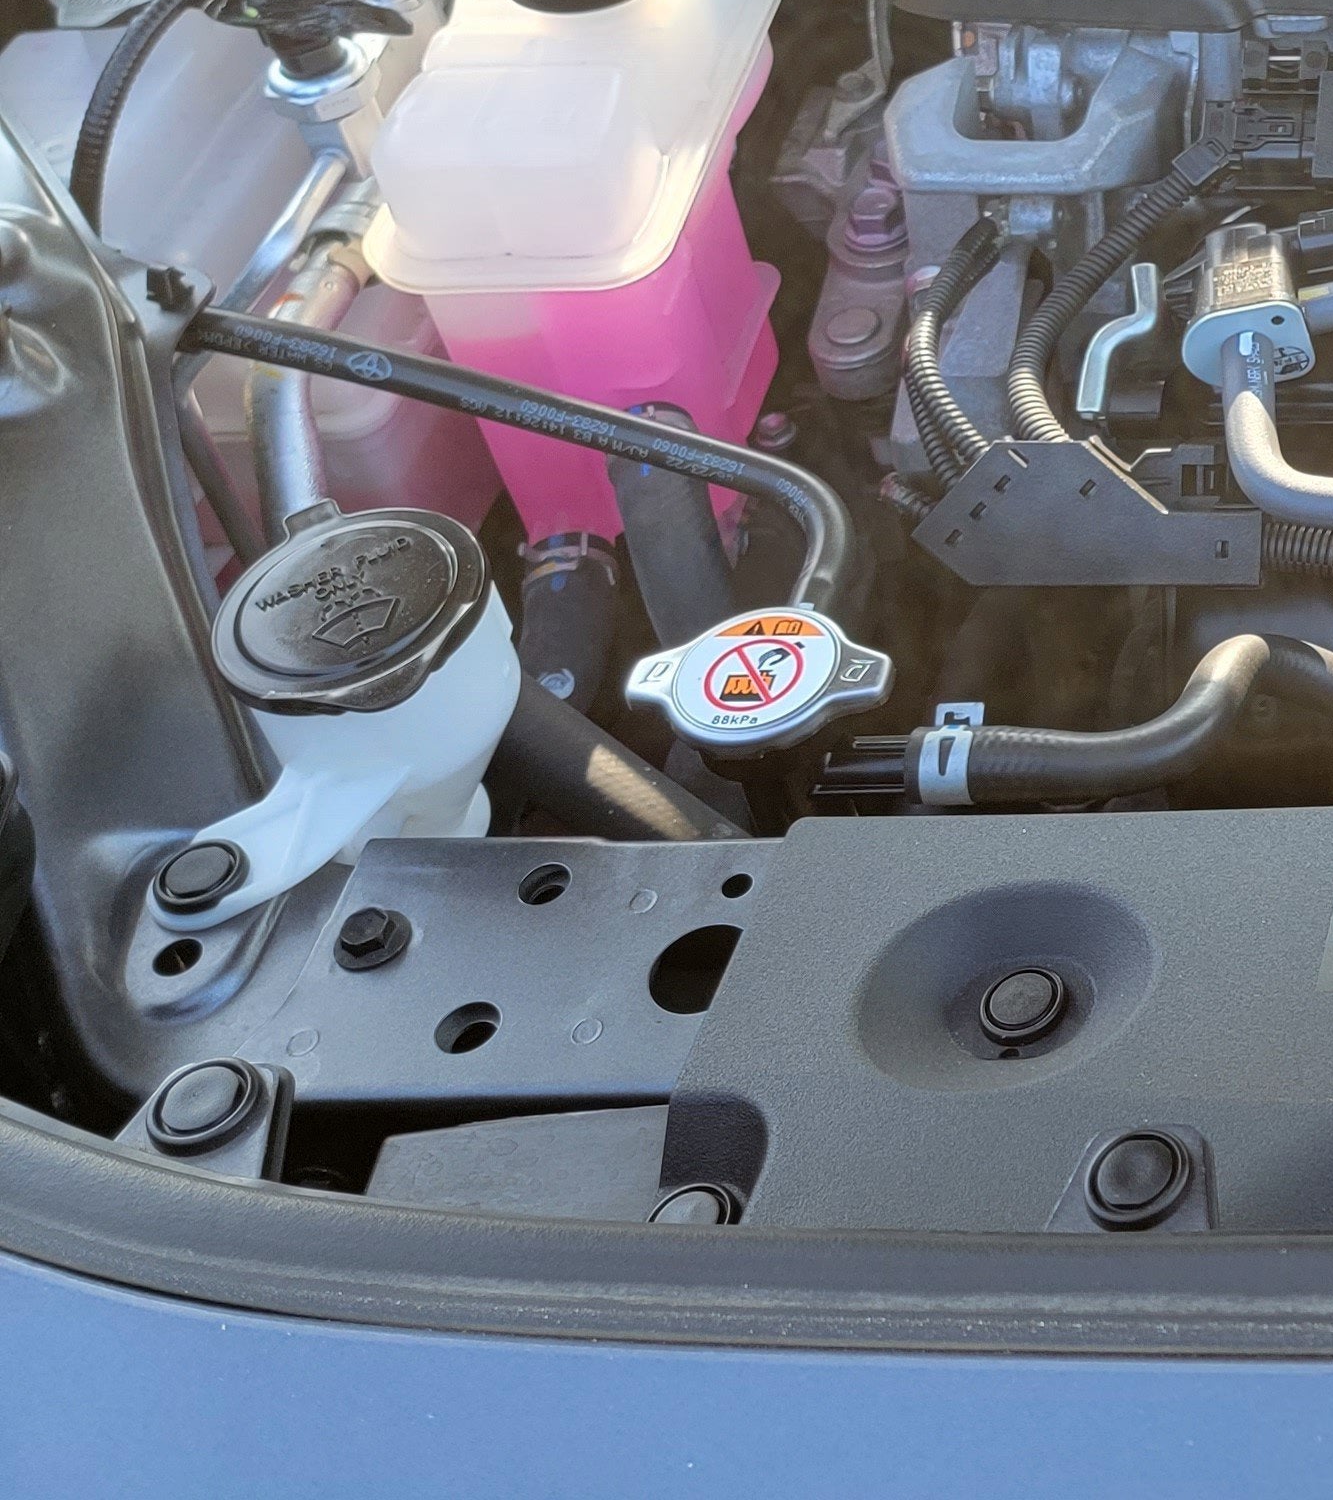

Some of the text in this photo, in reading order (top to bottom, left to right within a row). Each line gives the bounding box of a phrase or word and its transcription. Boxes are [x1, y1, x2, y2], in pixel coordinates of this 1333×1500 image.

[519, 396, 618, 439] 16283-F0060
[651, 436, 746, 476] 16283-F0060
[255, 536, 412, 613] WASHER FLUID
[315, 570, 366, 602] ONLY
[711, 714, 758, 726] 88kPa
